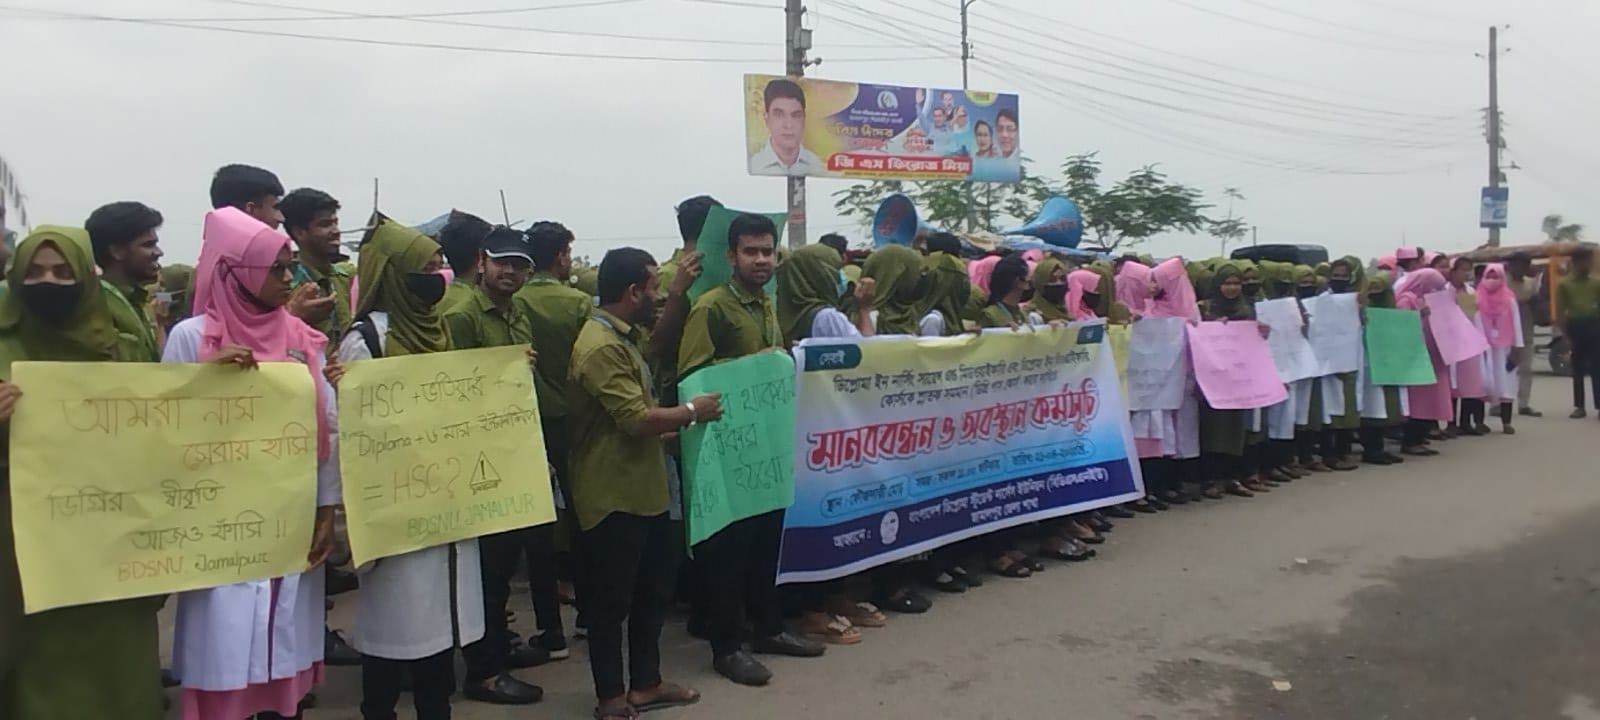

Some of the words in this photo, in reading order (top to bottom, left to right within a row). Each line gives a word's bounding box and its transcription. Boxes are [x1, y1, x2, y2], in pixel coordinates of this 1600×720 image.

[834, 154, 855, 168] জি
[860, 159, 883, 169] এস
[888, 157, 938, 171] ফিরোজ
[942, 158, 970, 172] মিয়া
[356, 380, 405, 419] HSC
[874, 372, 890, 390] ইন
[61, 394, 193, 436] আমরা
[202, 385, 264, 425] নার্স
[808, 416, 938, 472] মানববন্ধন
[940, 416, 956, 446] ও
[961, 399, 1030, 444] অবস্থান
[1031, 377, 1098, 434] কর্মসূচি
[260, 422, 313, 459] হাসি
